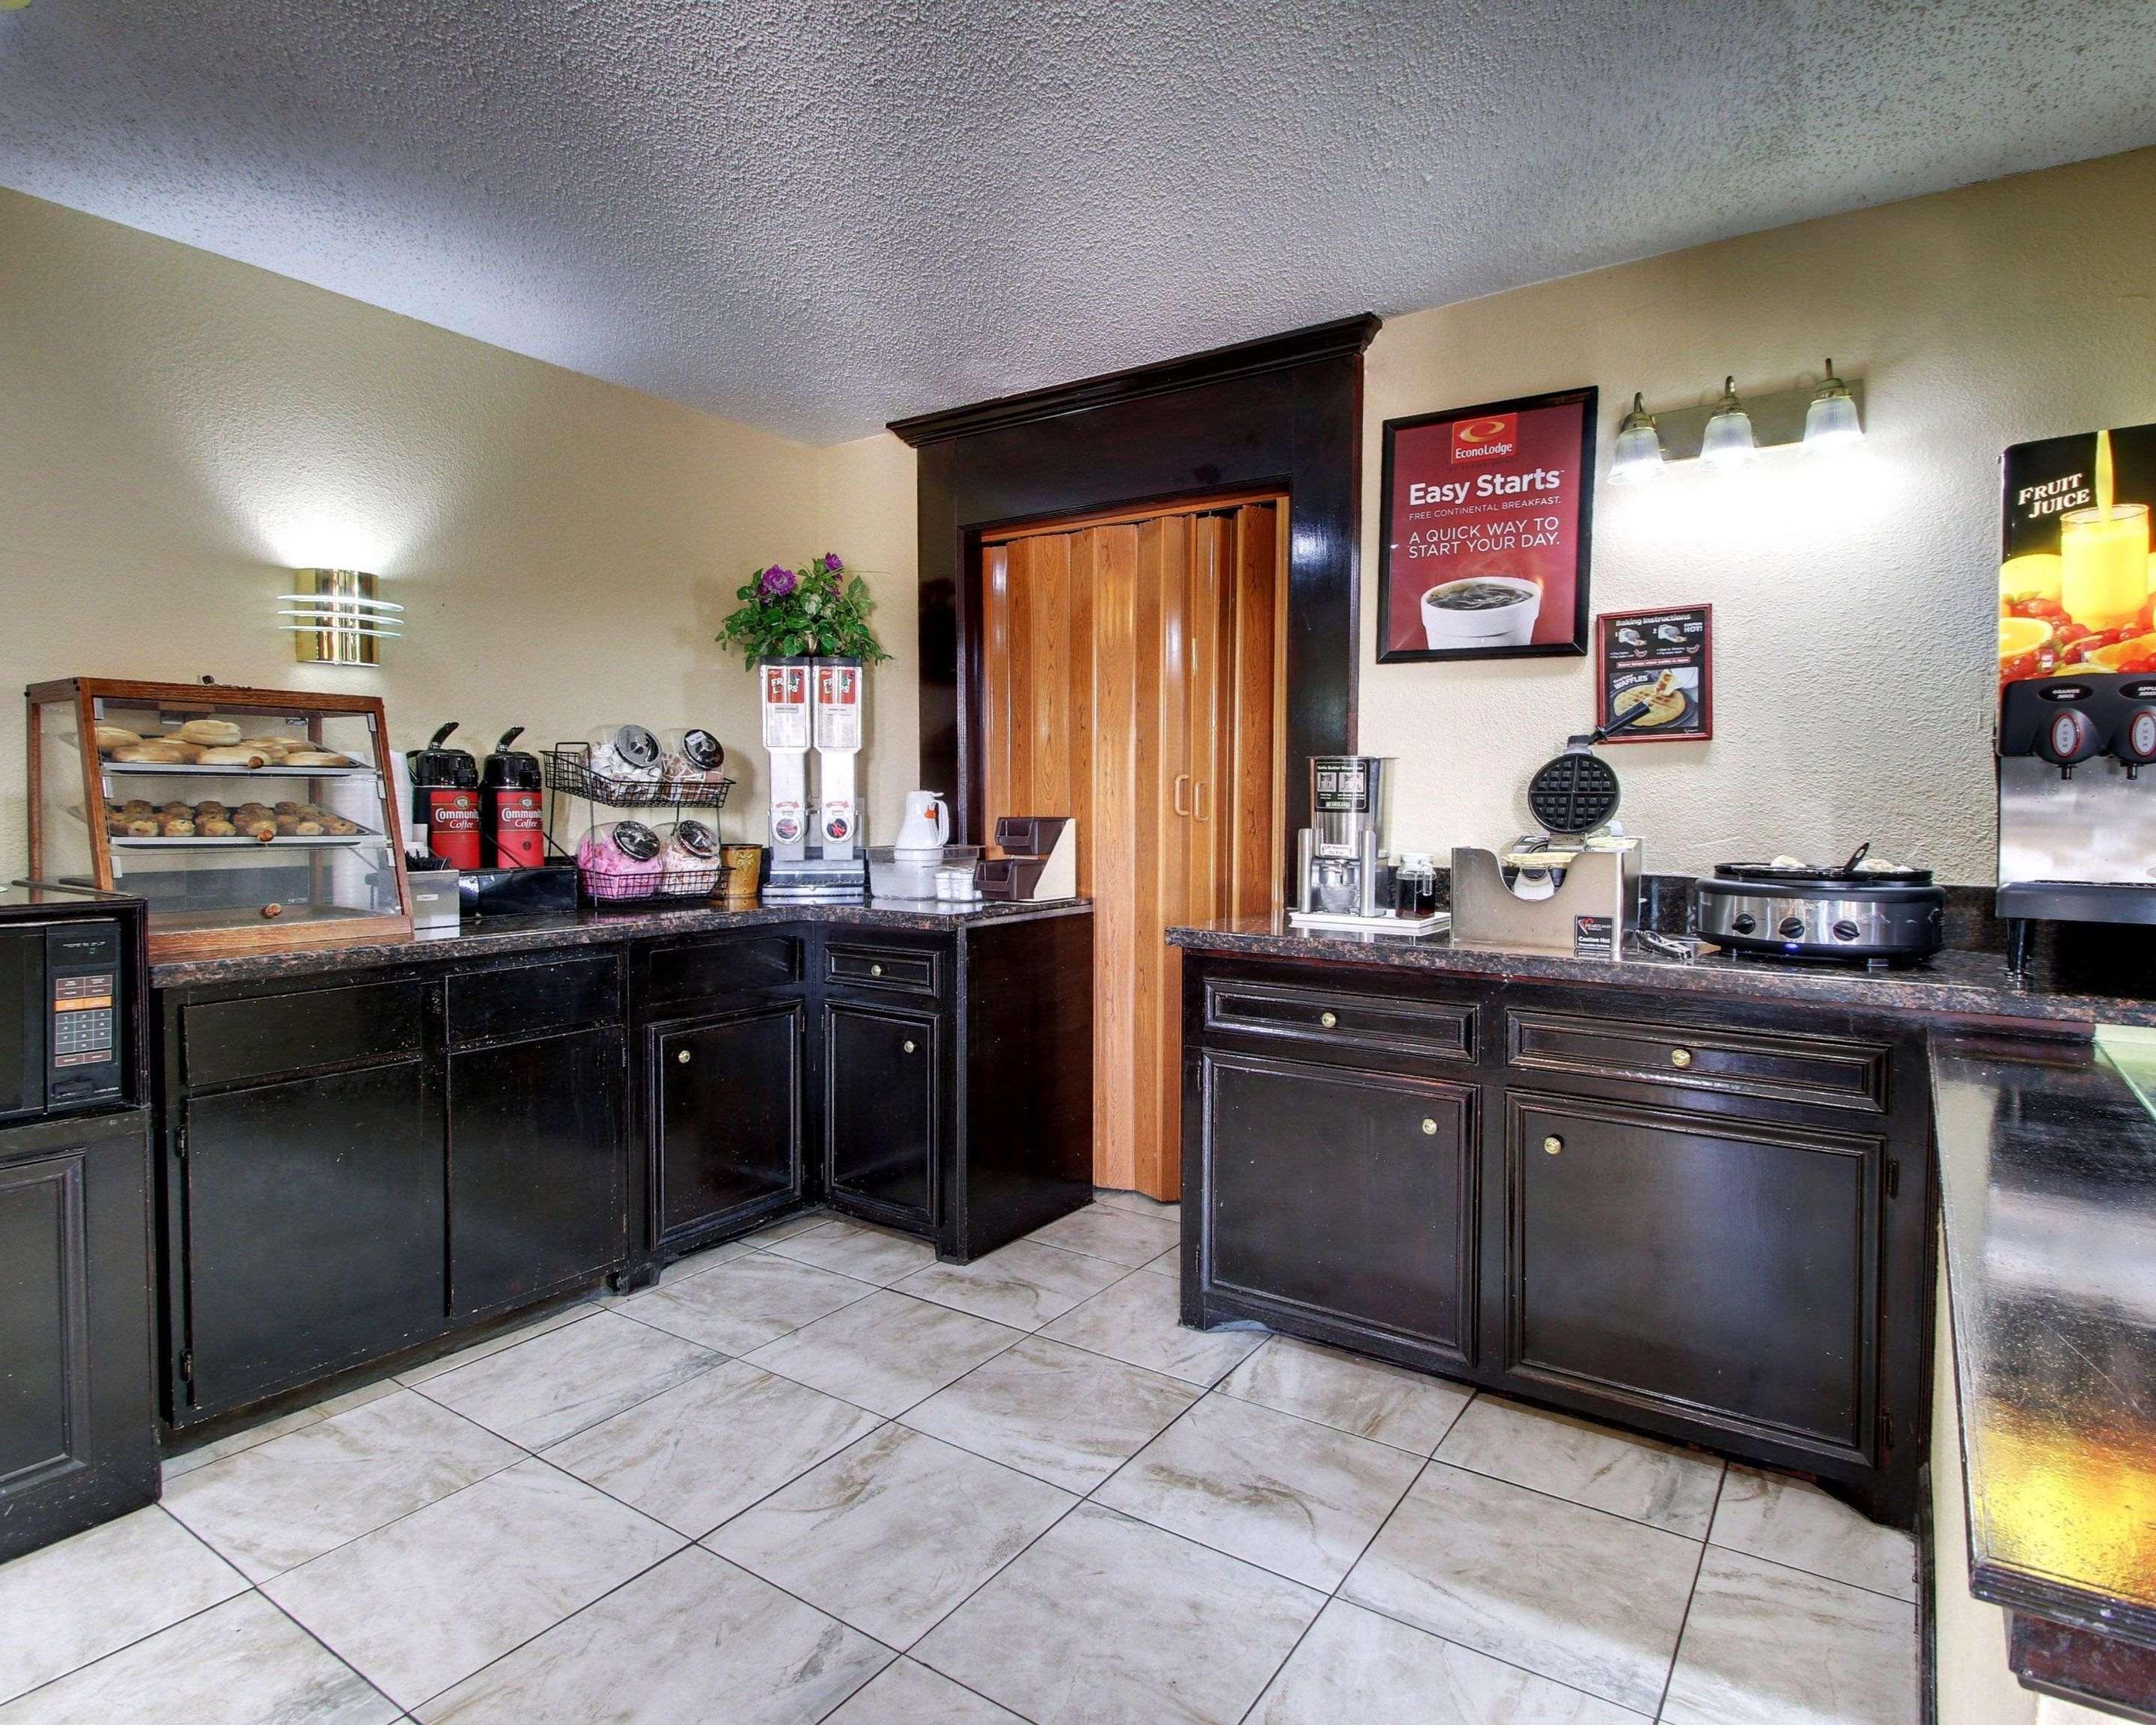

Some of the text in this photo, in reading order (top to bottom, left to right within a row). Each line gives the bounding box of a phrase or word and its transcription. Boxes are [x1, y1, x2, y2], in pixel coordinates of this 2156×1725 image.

[1410, 468, 1560, 506] Easy Starts
[2018, 473, 2083, 505] FRUIT
[1409, 496, 1561, 520] FREE CONTINENTAL BREAKFAST.
[2028, 488, 2090, 519] JUICE
[1409, 516, 1559, 544] A QUICK WAY TO
[1408, 532, 1560, 559] START YOUR DAY.
[1616, 614, 1691, 627] Baking Instructions
[449, 819, 473, 830] Coffee
[515, 818, 538, 829] Coffee
